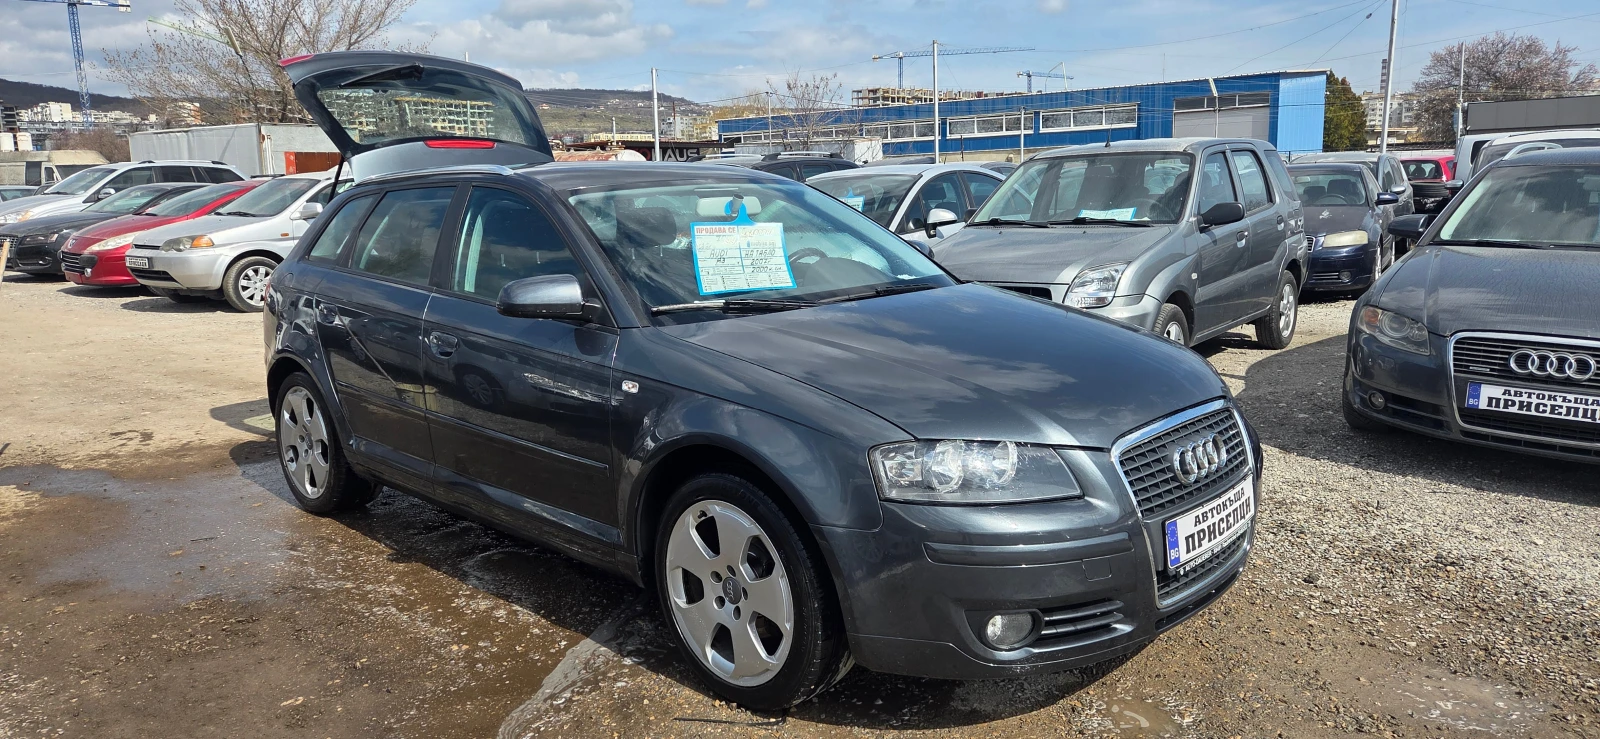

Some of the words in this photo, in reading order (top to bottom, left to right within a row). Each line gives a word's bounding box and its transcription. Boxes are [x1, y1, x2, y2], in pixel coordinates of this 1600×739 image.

[710, 249, 728, 257] AUDI
[1469, 398, 1479, 406] BG
[1501, 389, 1600, 407] АВТОКЪЩА
[1486, 396, 1600, 421] ПРИСЕЛЦ
[1193, 486, 1245, 527] АВТОКЪЩА
[1184, 496, 1251, 555] ПРИСЕЛЦИ
[1170, 547, 1180, 560] BG
